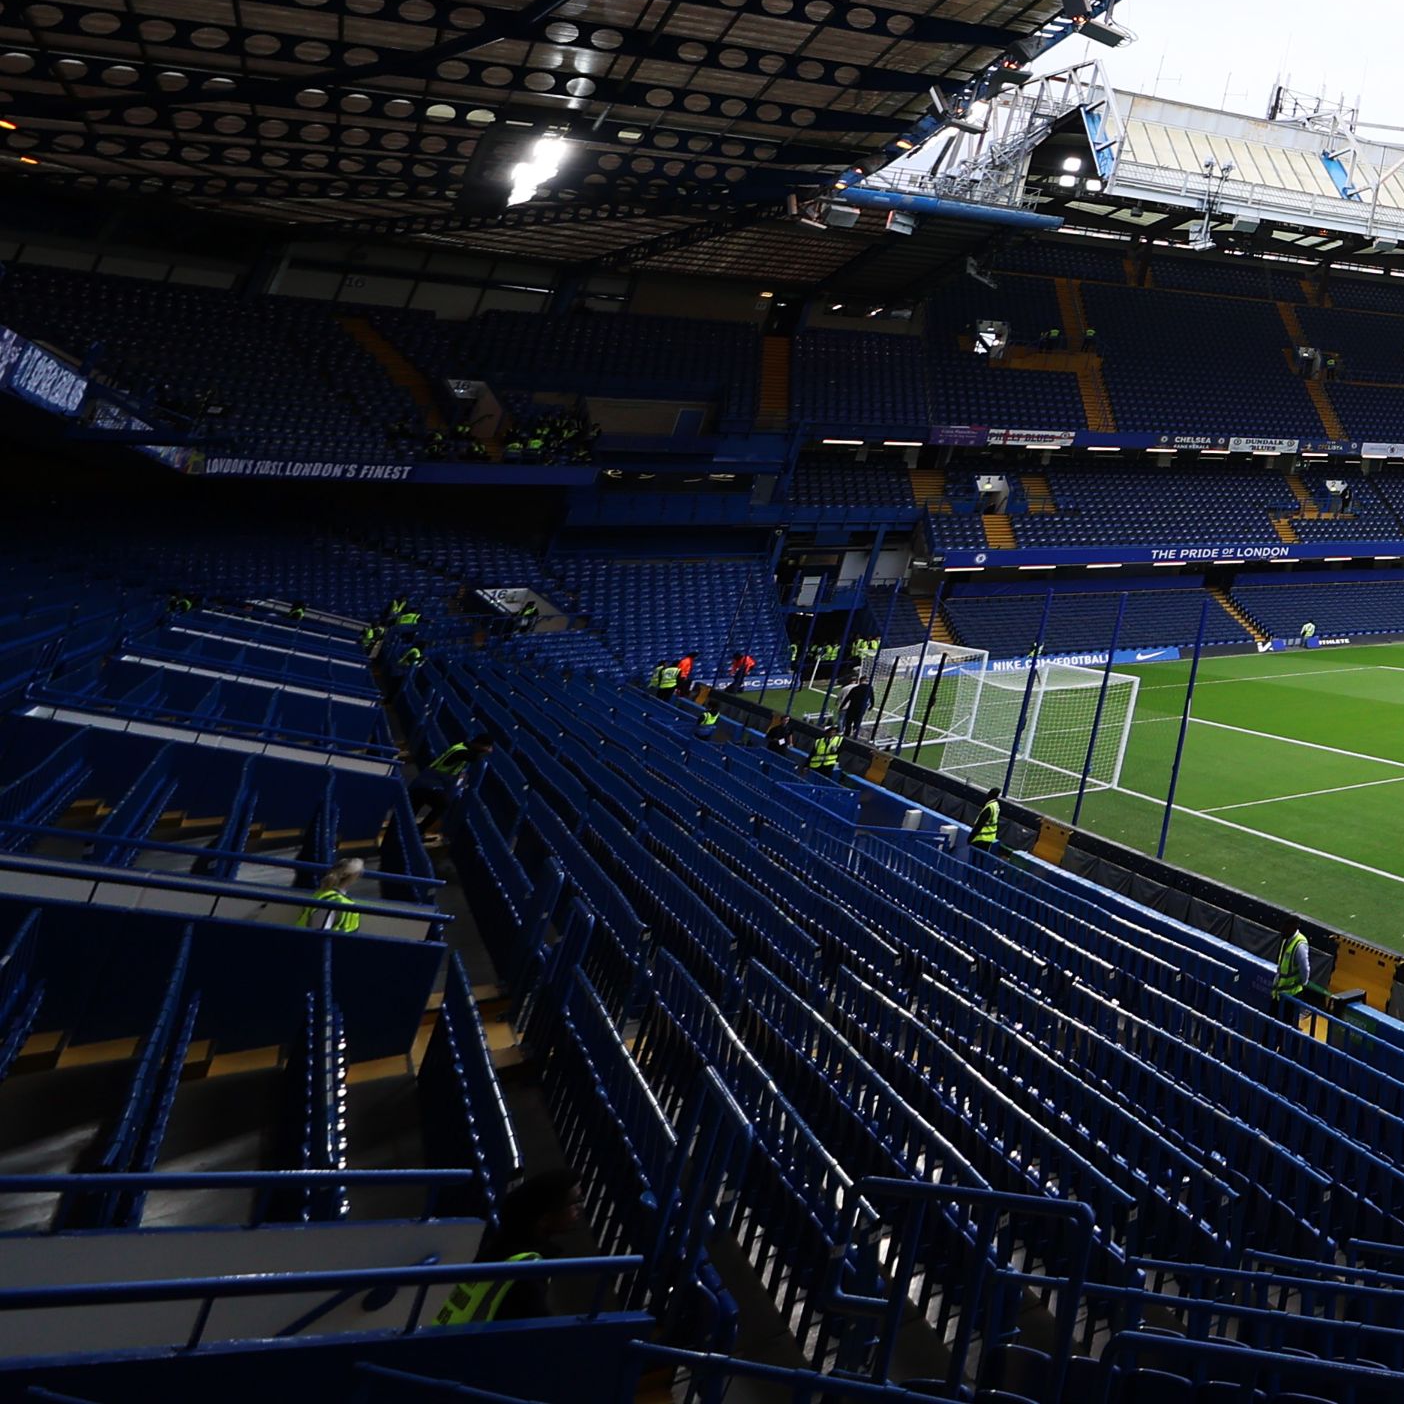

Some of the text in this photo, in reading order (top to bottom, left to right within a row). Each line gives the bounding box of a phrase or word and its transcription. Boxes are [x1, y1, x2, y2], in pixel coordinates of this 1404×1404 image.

[455, 380, 472, 390] 16
[1175, 436, 1211, 444] CHELSEA
[286, 462, 358, 478] LONDON'S
[358, 464, 413, 480] FINEST
[1151, 549, 1177, 559] THE
[1180, 549, 1219, 558] PRIDE
[1237, 547, 1289, 557] LONDON
[491, 590, 508, 599] 16
